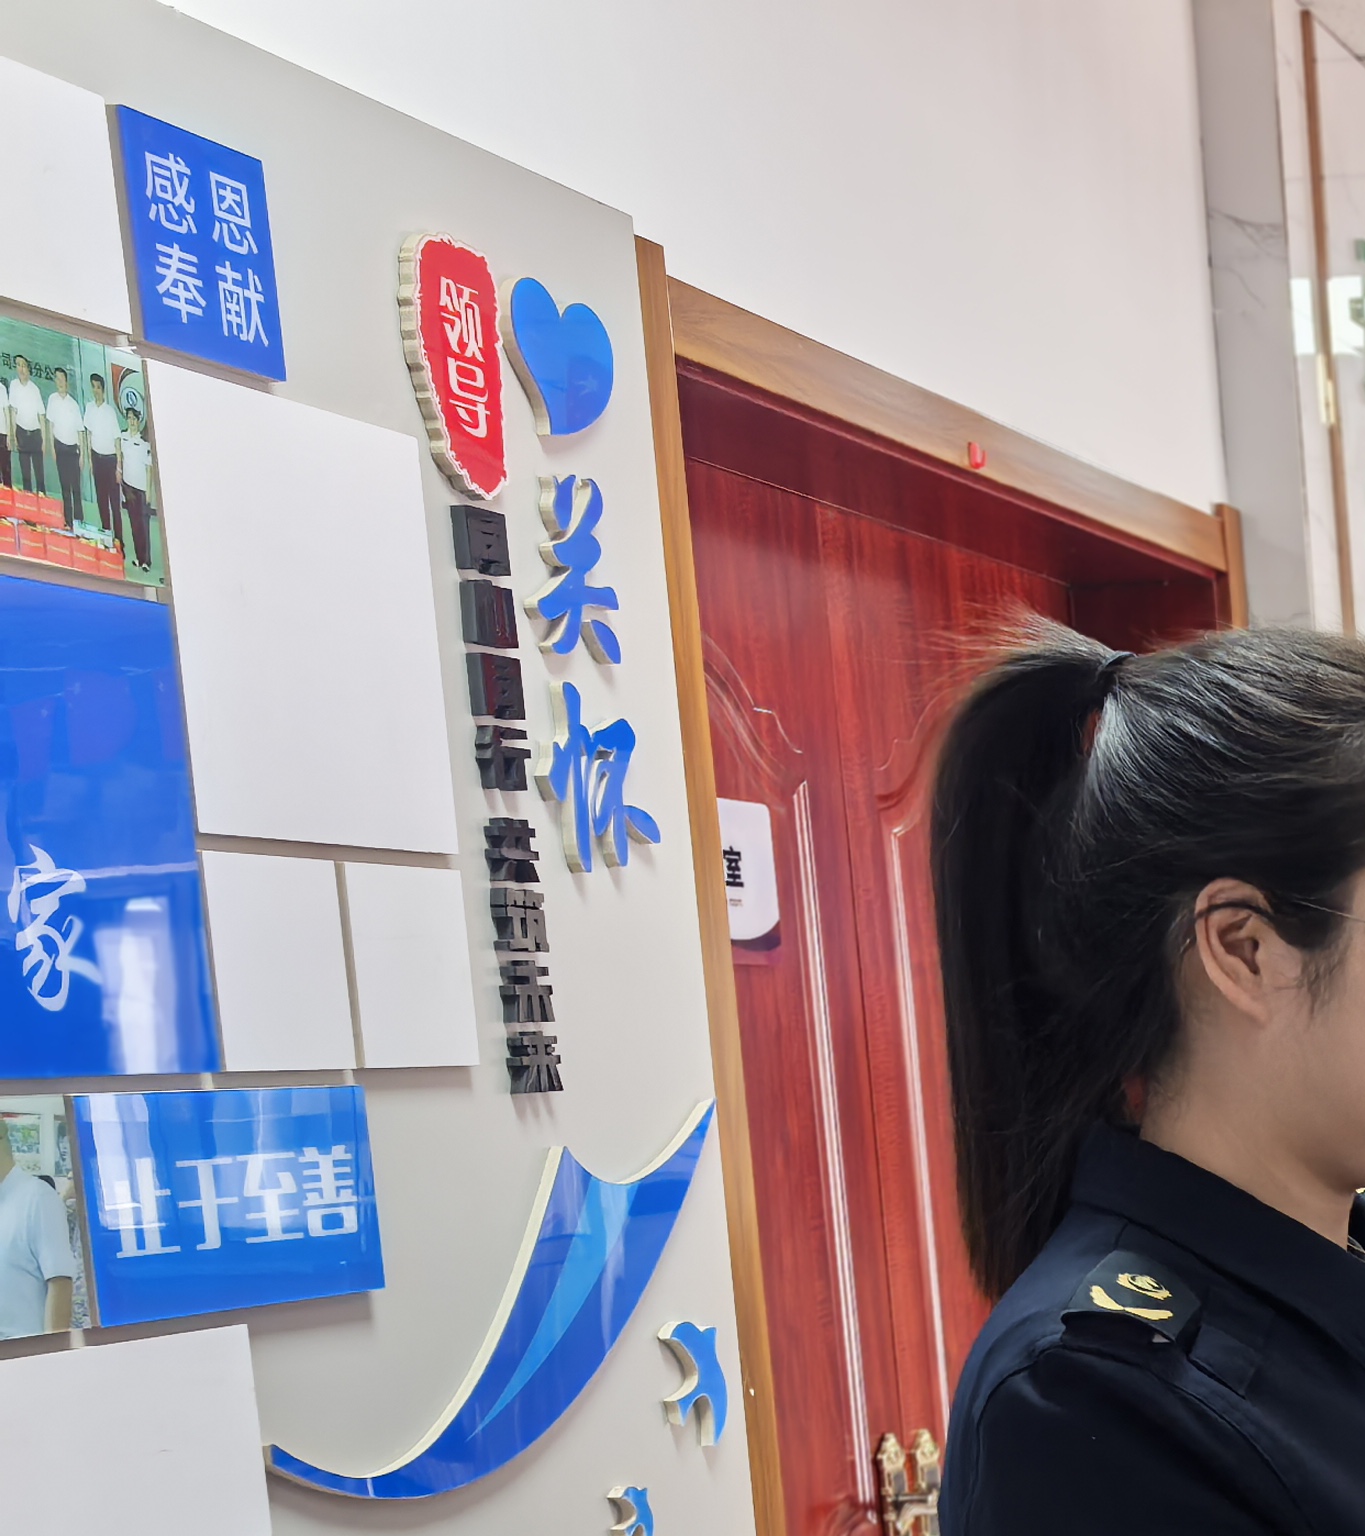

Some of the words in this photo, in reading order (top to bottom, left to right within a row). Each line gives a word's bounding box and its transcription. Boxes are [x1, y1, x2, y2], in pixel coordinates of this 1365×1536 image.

[144, 153, 256, 256] 感恩
[154, 242, 270, 349] 奉献
[438, 277, 491, 438] 领导
[523, 474, 661, 873] 关怀
[6, 842, 104, 1013] 家
[483, 817, 565, 1095] 共筑未来
[112, 1144, 360, 1260] 止于至善
